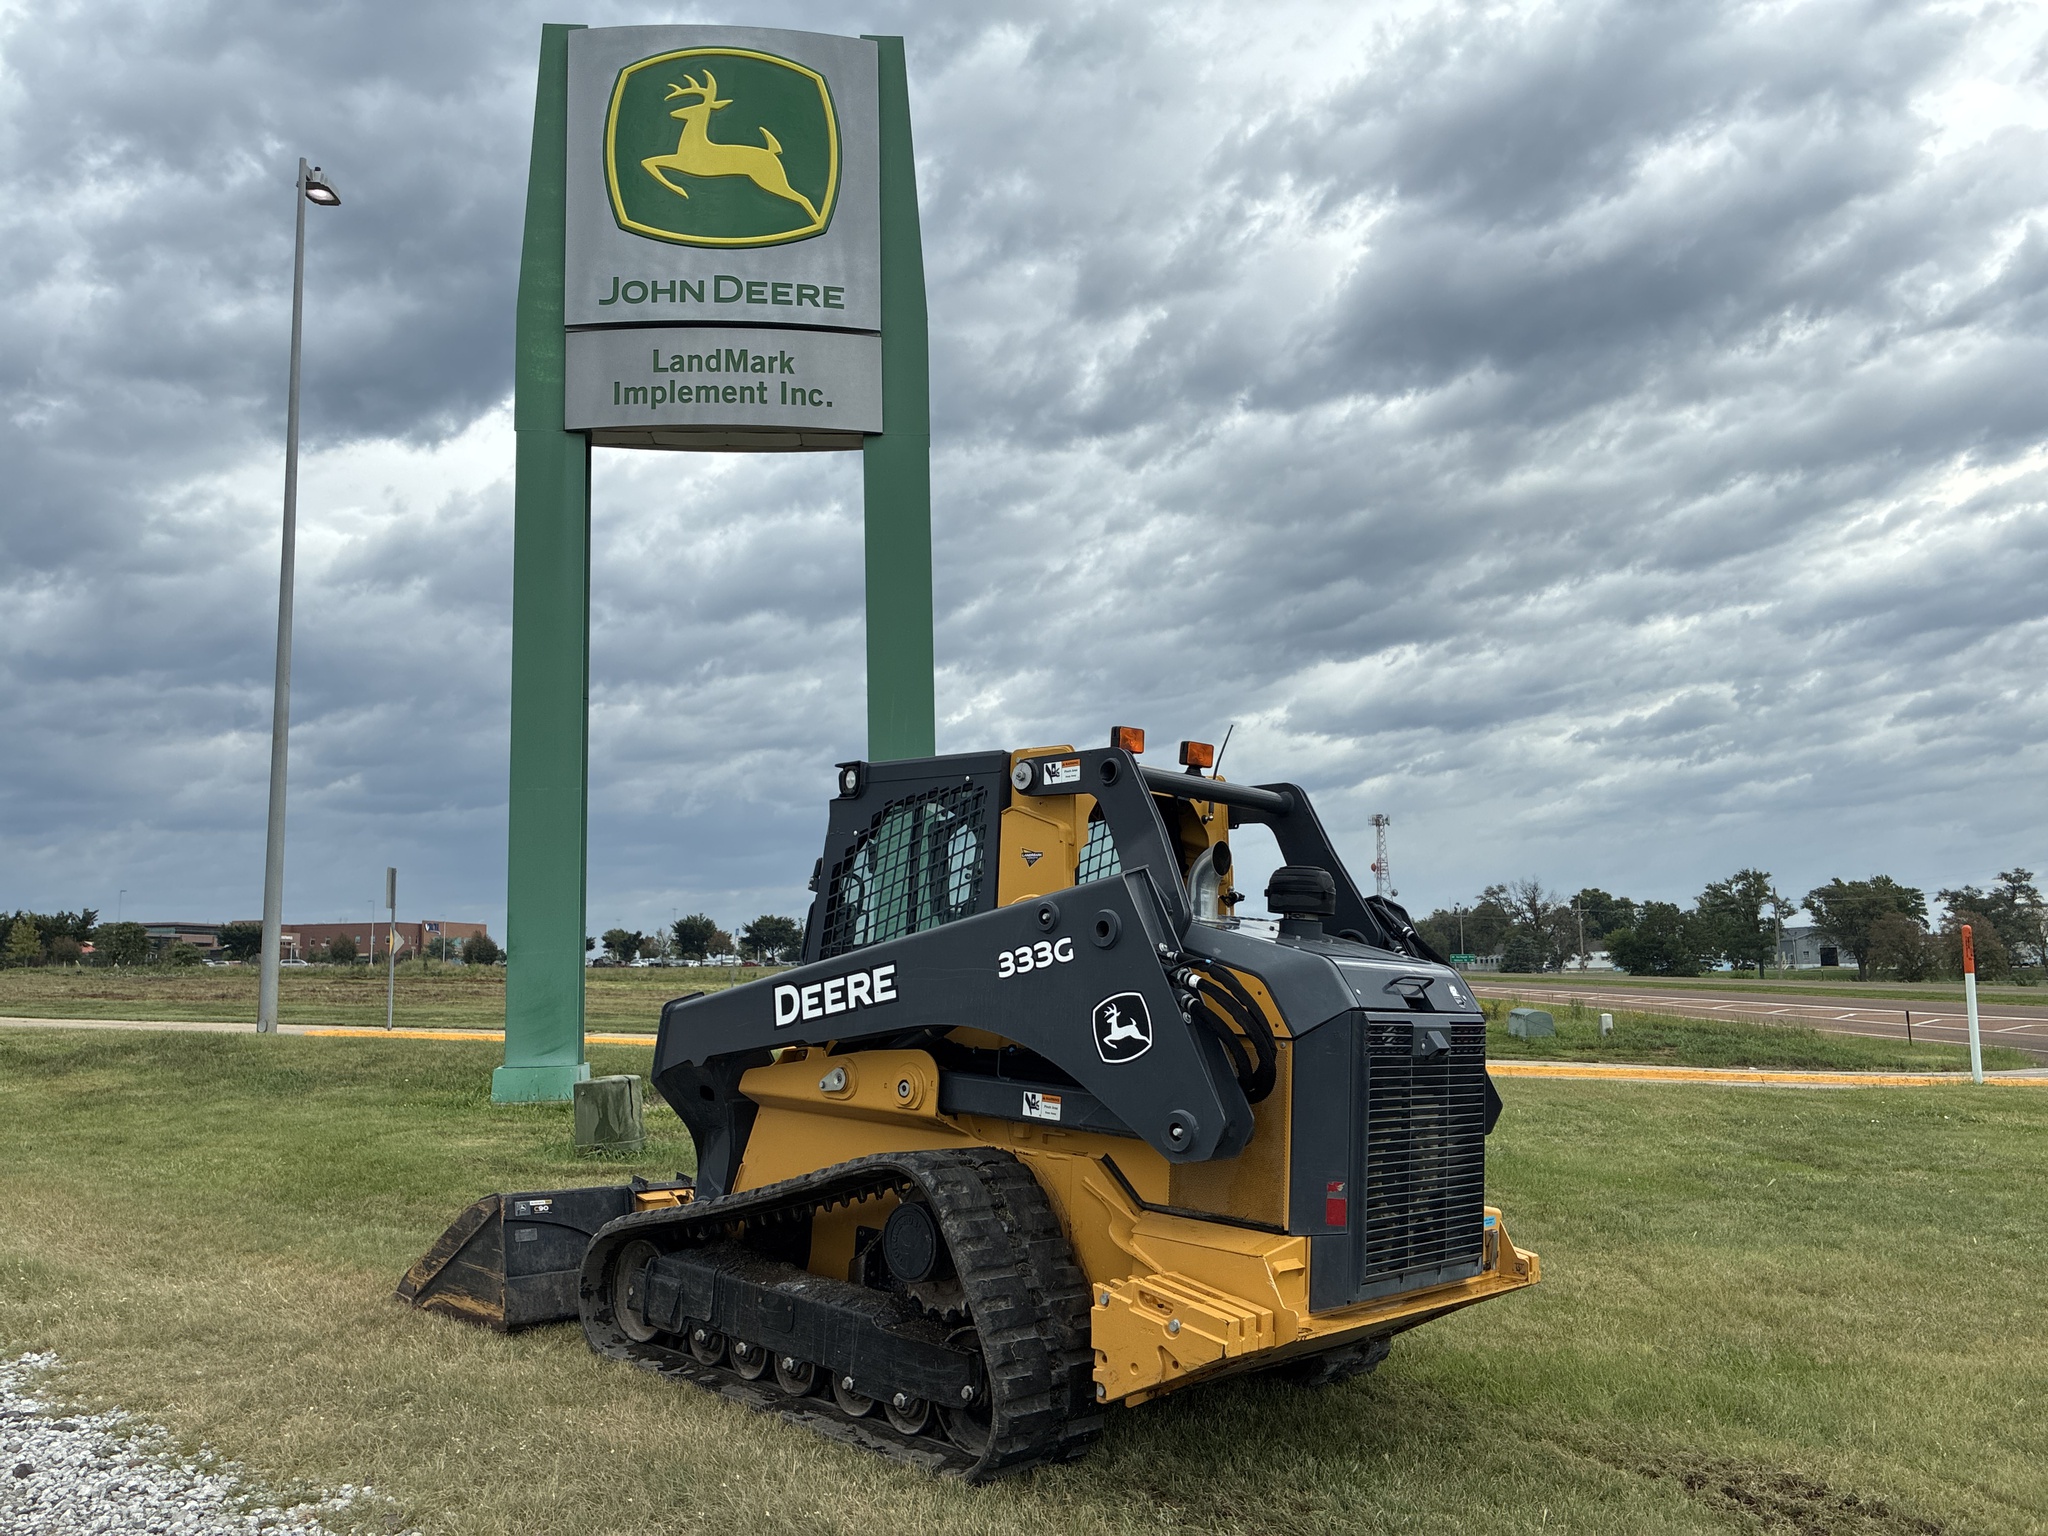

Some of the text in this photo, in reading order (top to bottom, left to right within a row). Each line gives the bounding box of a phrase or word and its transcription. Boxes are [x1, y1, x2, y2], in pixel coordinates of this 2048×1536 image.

[599, 275, 845, 310] JOHN DEERE
[652, 348, 796, 375] LandMark
[613, 379, 834, 410] Implement Inc.
[998, 937, 1075, 979] 333G
[773, 964, 898, 1028] DEERE
